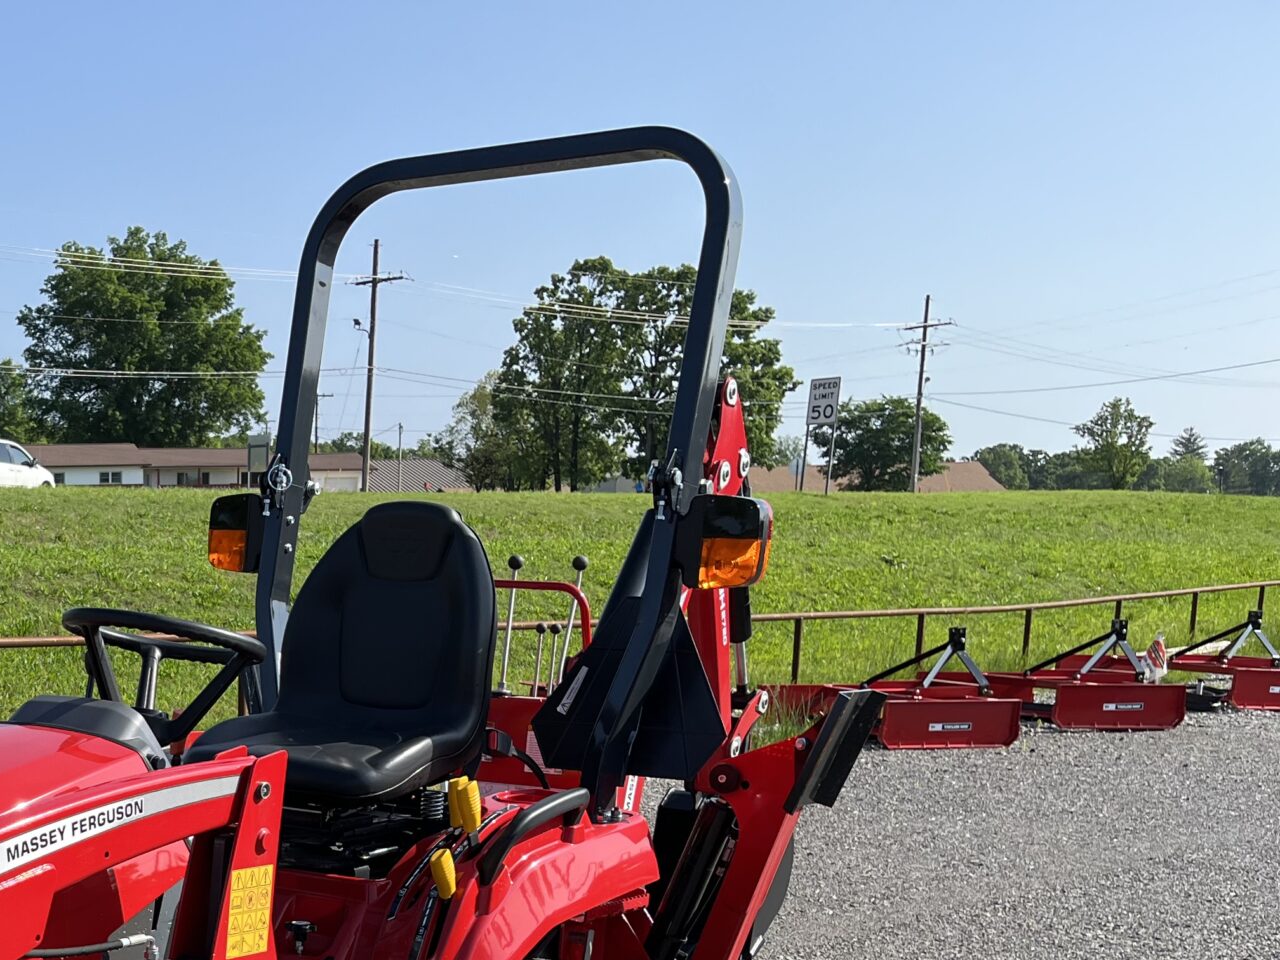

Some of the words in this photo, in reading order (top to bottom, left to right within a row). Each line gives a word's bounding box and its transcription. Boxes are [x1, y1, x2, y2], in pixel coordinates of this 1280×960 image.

[812, 381, 838, 390] SPEED
[813, 391, 834, 400] LIMIT
[810, 404, 834, 420] 50
[6, 825, 67, 862] MASSEY
[71, 799, 144, 837] FERGUSON
